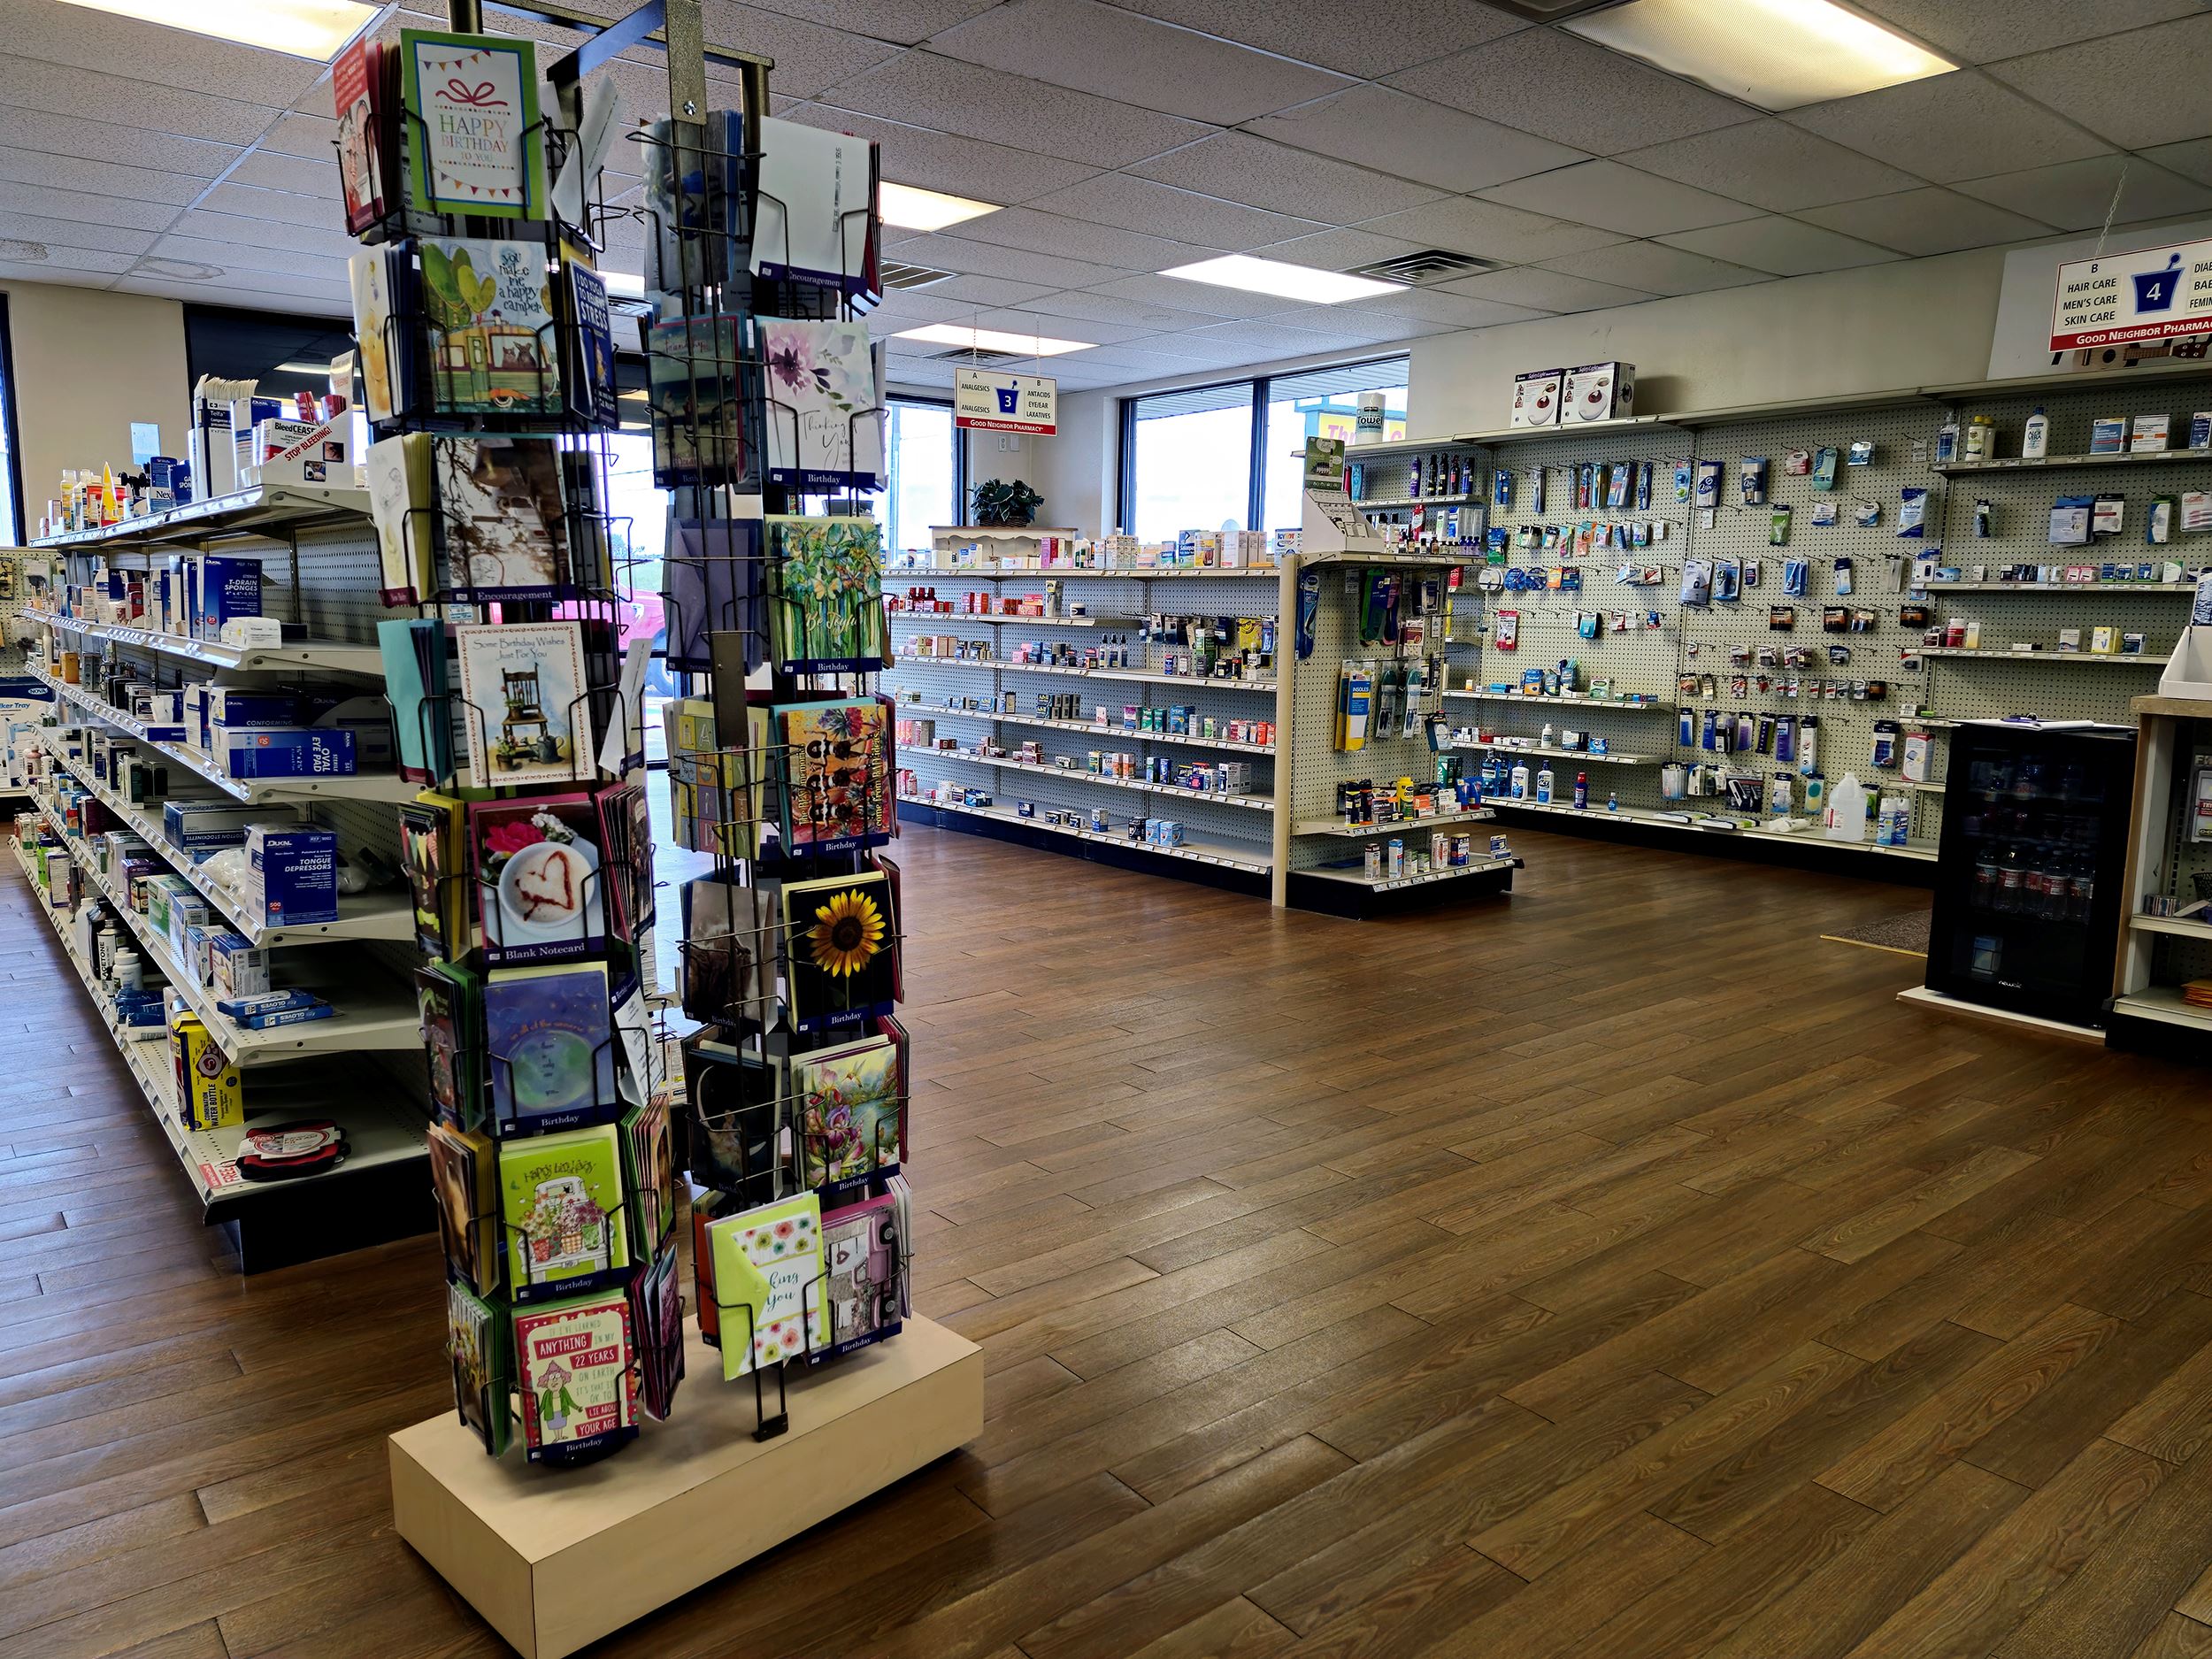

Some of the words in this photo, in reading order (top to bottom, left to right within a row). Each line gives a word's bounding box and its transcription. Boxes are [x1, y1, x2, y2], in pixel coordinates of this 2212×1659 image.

[440, 114, 508, 138] HAPPY
[442, 134, 508, 153] BIRTHDAY
[461, 151, 471, 161] TO
[475, 152, 493, 162] YOU
[502, 252, 521, 265] you
[499, 265, 530, 276] make
[2091, 264, 2099, 273] B
[509, 276, 525, 287] me
[2068, 282, 2090, 293] HAIR
[2092, 278, 2116, 290] CARE
[506, 286, 538, 303] happy
[2146, 283, 2162, 301] 4
[503, 299, 541, 316] camper
[2063, 298, 2091, 310] MEN'S
[2093, 295, 2117, 306] CARE
[581, 302, 609, 331] STRESS
[2065, 315, 2087, 326] SKIN
[2090, 311, 2116, 323] CARE
[2077, 334, 2106, 345] GOOD
[2108, 327, 2161, 341] NEIGHBOR
[961, 383, 990, 392] ANALGESICS
[1027, 390, 1051, 399] ANTACIDS
[961, 404, 990, 414] ANALGESICS
[1004, 396, 1011, 407] 3
[987, 421, 1014, 430] NEIGHBOR
[1014, 423, 1042, 432] PHARMACY
[1357, 416, 1383, 425] Towel
[284, 446, 302, 462] STOP
[300, 426, 333, 451] BLEEDING!
[807, 473, 841, 484] Birthday
[477, 589, 553, 602] Encouragement
[472, 638, 498, 650] Some
[499, 637, 534, 651] Birthday
[535, 636, 565, 649] Wishes
[495, 649, 515, 661] Just
[516, 649, 533, 659] For
[532, 648, 548, 660] You
[818, 663, 849, 672] Birthday
[311, 736, 321, 753] EYE
[311, 754, 322, 772] PAD
[321, 748, 330, 772] OVAL
[872, 780, 882, 803] from
[798, 810, 810, 826] The
[826, 841, 856, 851] Birthday
[284, 864, 332, 872] DEPRESSORS
[505, 948, 537, 960] Blank
[539, 943, 586, 956] Notecard
[260, 1000, 287, 1009] GLOVES
[280, 1011, 305, 1021] GLOVES
[831, 1011, 862, 1025] Birthday
[208, 1083, 218, 1105] BOTTLE
[202, 1091, 211, 1121] COMBINATION
[209, 1106, 219, 1127] WATER
[541, 1114, 580, 1127] Birthday
[839, 1176, 870, 1191] Birthday
[555, 1278, 593, 1293] Birthday
[766, 1292, 795, 1312] you
[540, 1336, 588, 1356] ANYTHING
[595, 1335, 603, 1345] IN
[605, 1333, 615, 1343] MY
[841, 1337, 872, 1353] Birthday
[575, 1355, 588, 1368] 22
[588, 1349, 615, 1364] YEARS
[579, 1371, 590, 1382] ON
[593, 1367, 615, 1380] EARTH
[589, 1394, 600, 1403] OK
[603, 1391, 612, 1402] TO
[588, 1407, 599, 1417] LIE
[580, 1422, 601, 1436] YOUR
[603, 1417, 618, 1430] AGE
[566, 1438, 603, 1453] Birthday
